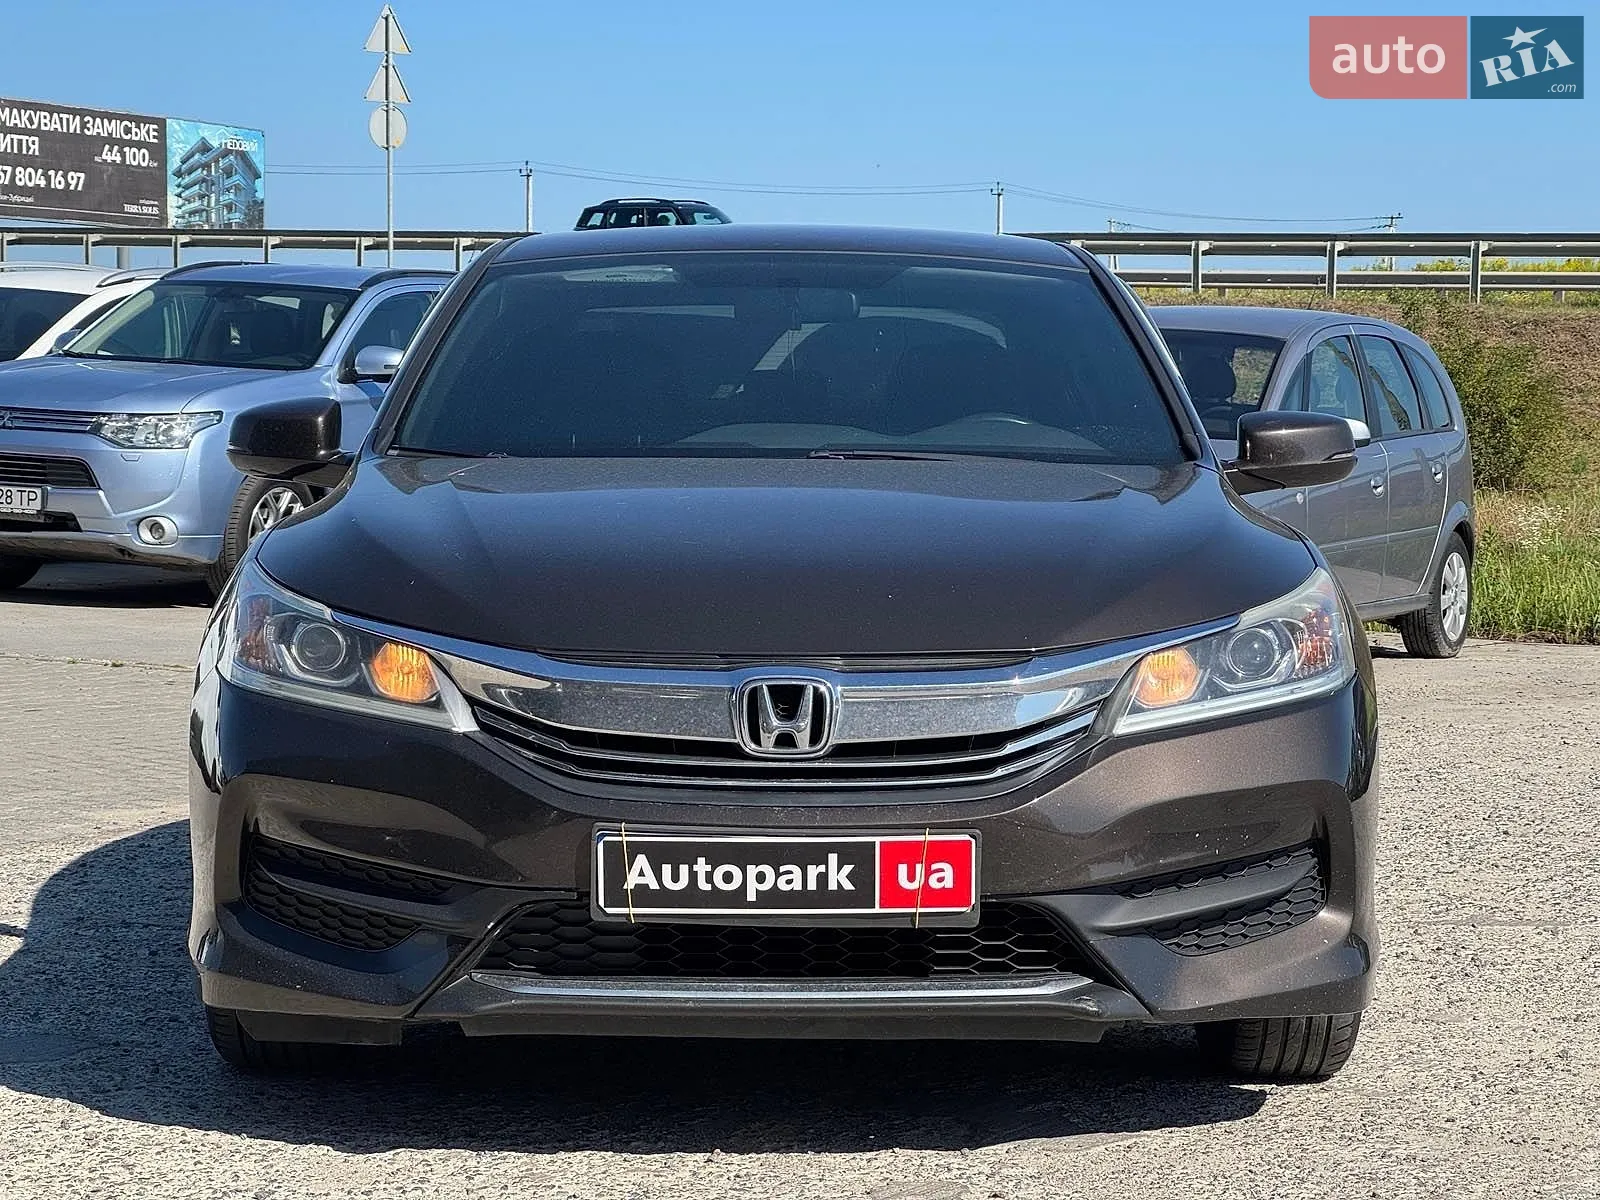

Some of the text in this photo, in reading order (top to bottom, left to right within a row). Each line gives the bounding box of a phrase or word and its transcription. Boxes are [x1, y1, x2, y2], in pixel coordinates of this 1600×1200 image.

[83, 115, 159, 143] ЗАМІСЬКЕ
[101, 144, 150, 167] 44 100
[15, 166, 47, 188] 804
[47, 169, 65, 190] 16
[67, 171, 85, 191] 97
[623, 852, 955, 902] Autopark ua
